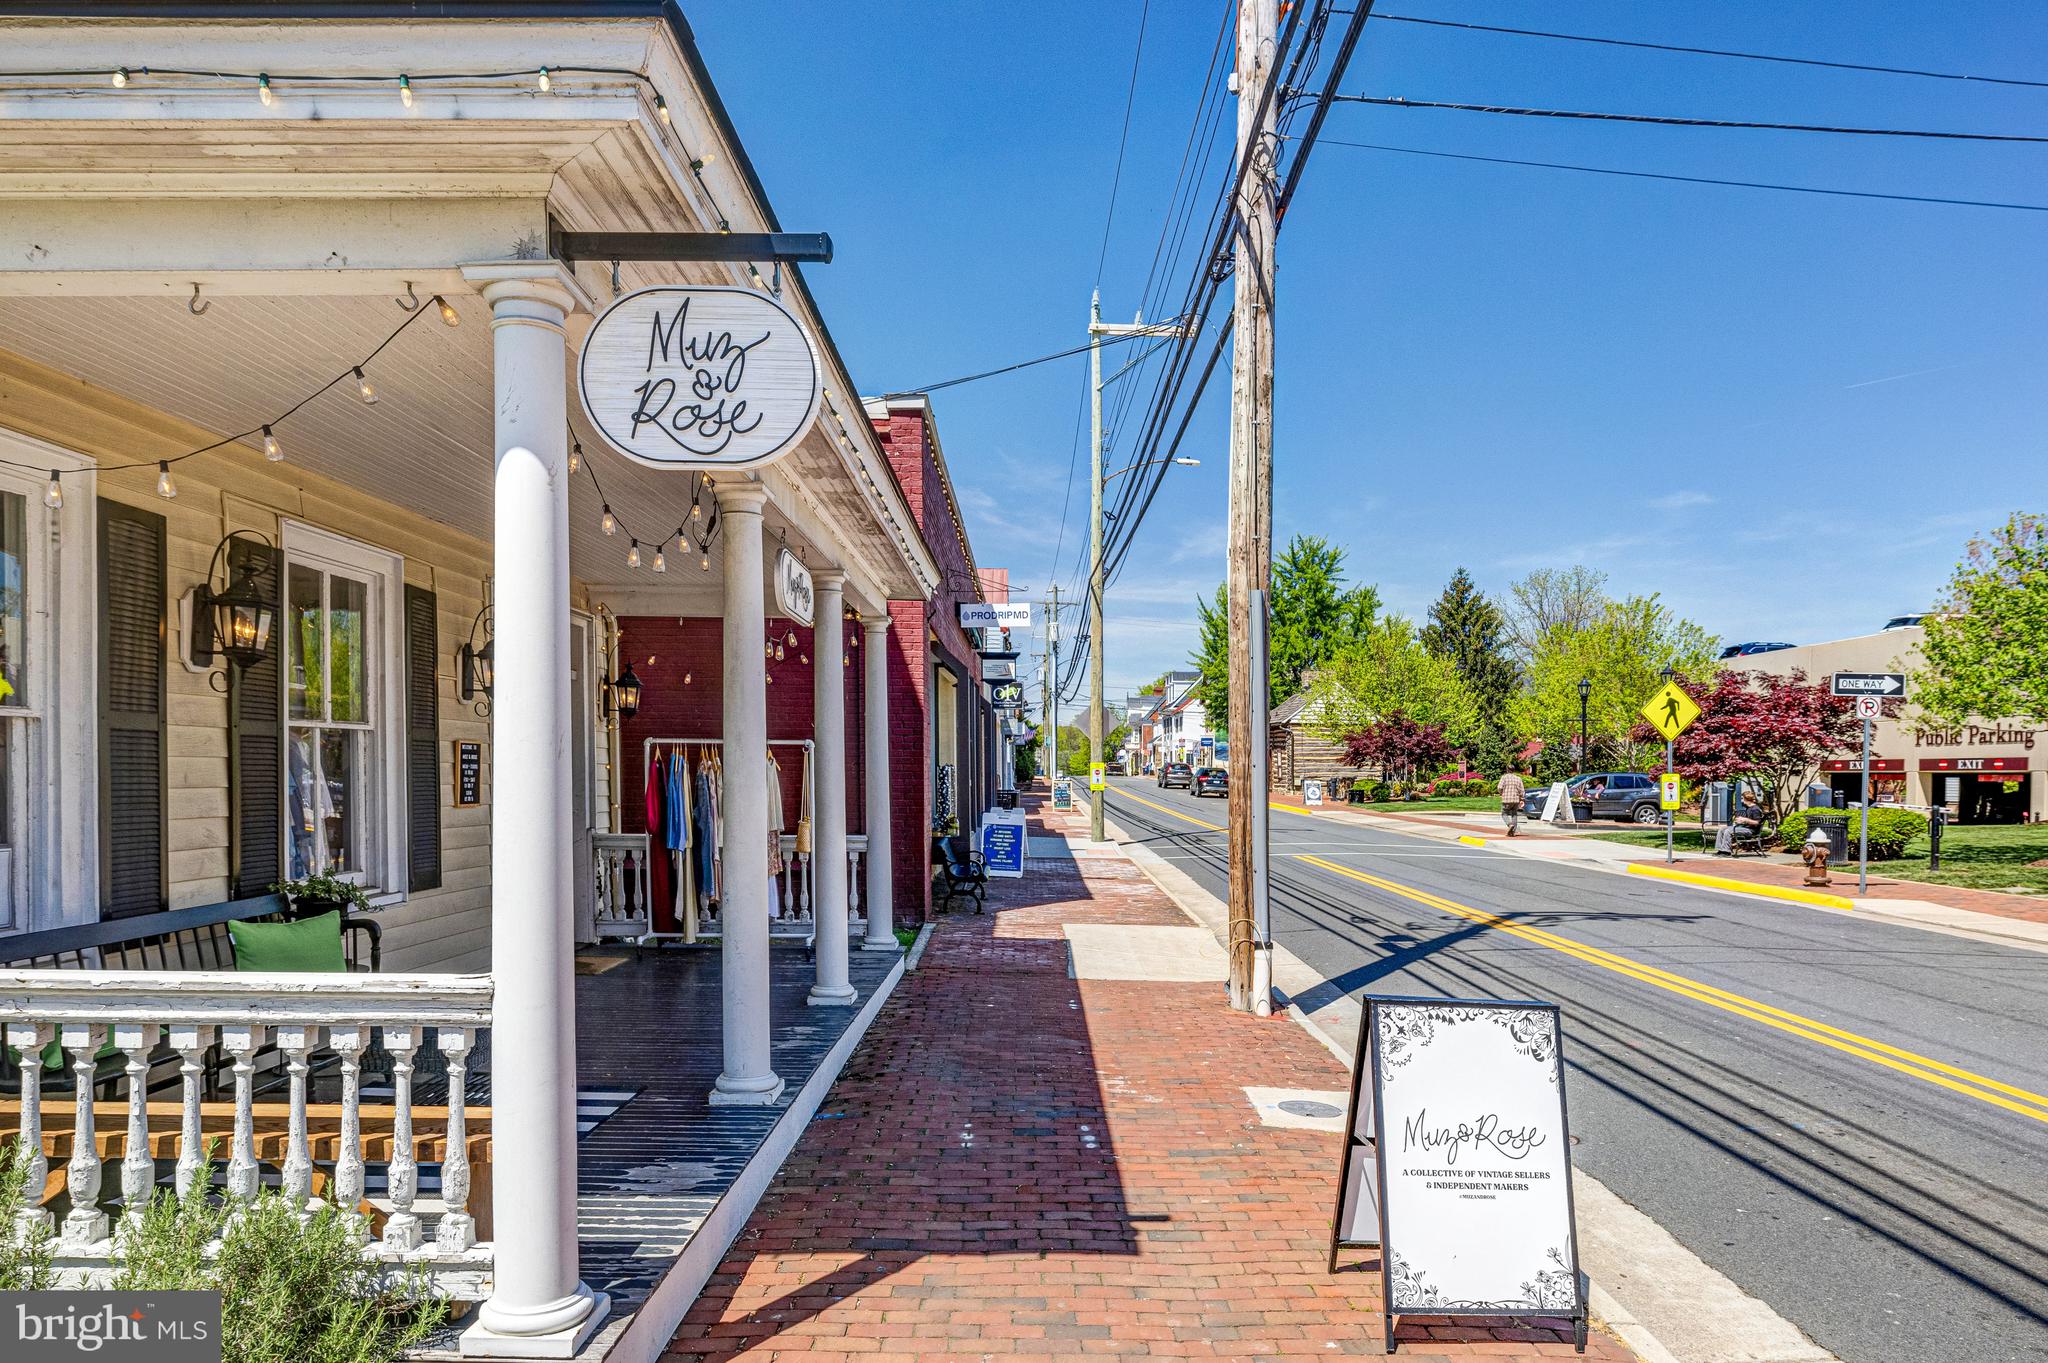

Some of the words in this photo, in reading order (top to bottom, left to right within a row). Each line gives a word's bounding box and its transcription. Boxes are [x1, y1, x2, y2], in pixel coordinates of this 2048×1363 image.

[647, 297, 771, 393] Muz
[692, 368, 722, 400] &
[631, 378, 763, 455] Rose
[1841, 679, 1861, 689] ONE
[1863, 679, 1884, 689] WAY
[1915, 726, 1963, 747] Public
[1968, 723, 2035, 749] Parking
[1849, 760, 1864, 770] EXI
[1957, 759, 1984, 770] EXIT
[1403, 1108, 1459, 1165] Muz
[1475, 1114, 1546, 1160] Rose
[1402, 1169, 1409, 1177] A
[1410, 1169, 1463, 1178] COLLECTIVE
[1464, 1170, 1476, 1178] OF
[1477, 1170, 1513, 1179] VINTAGE
[1514, 1171, 1551, 1180] SELLERS
[1426, 1181, 1432, 1189] &
[1433, 1181, 1493, 1190] INDEPENDENT
[1493, 1182, 1529, 1191] MAKERS
